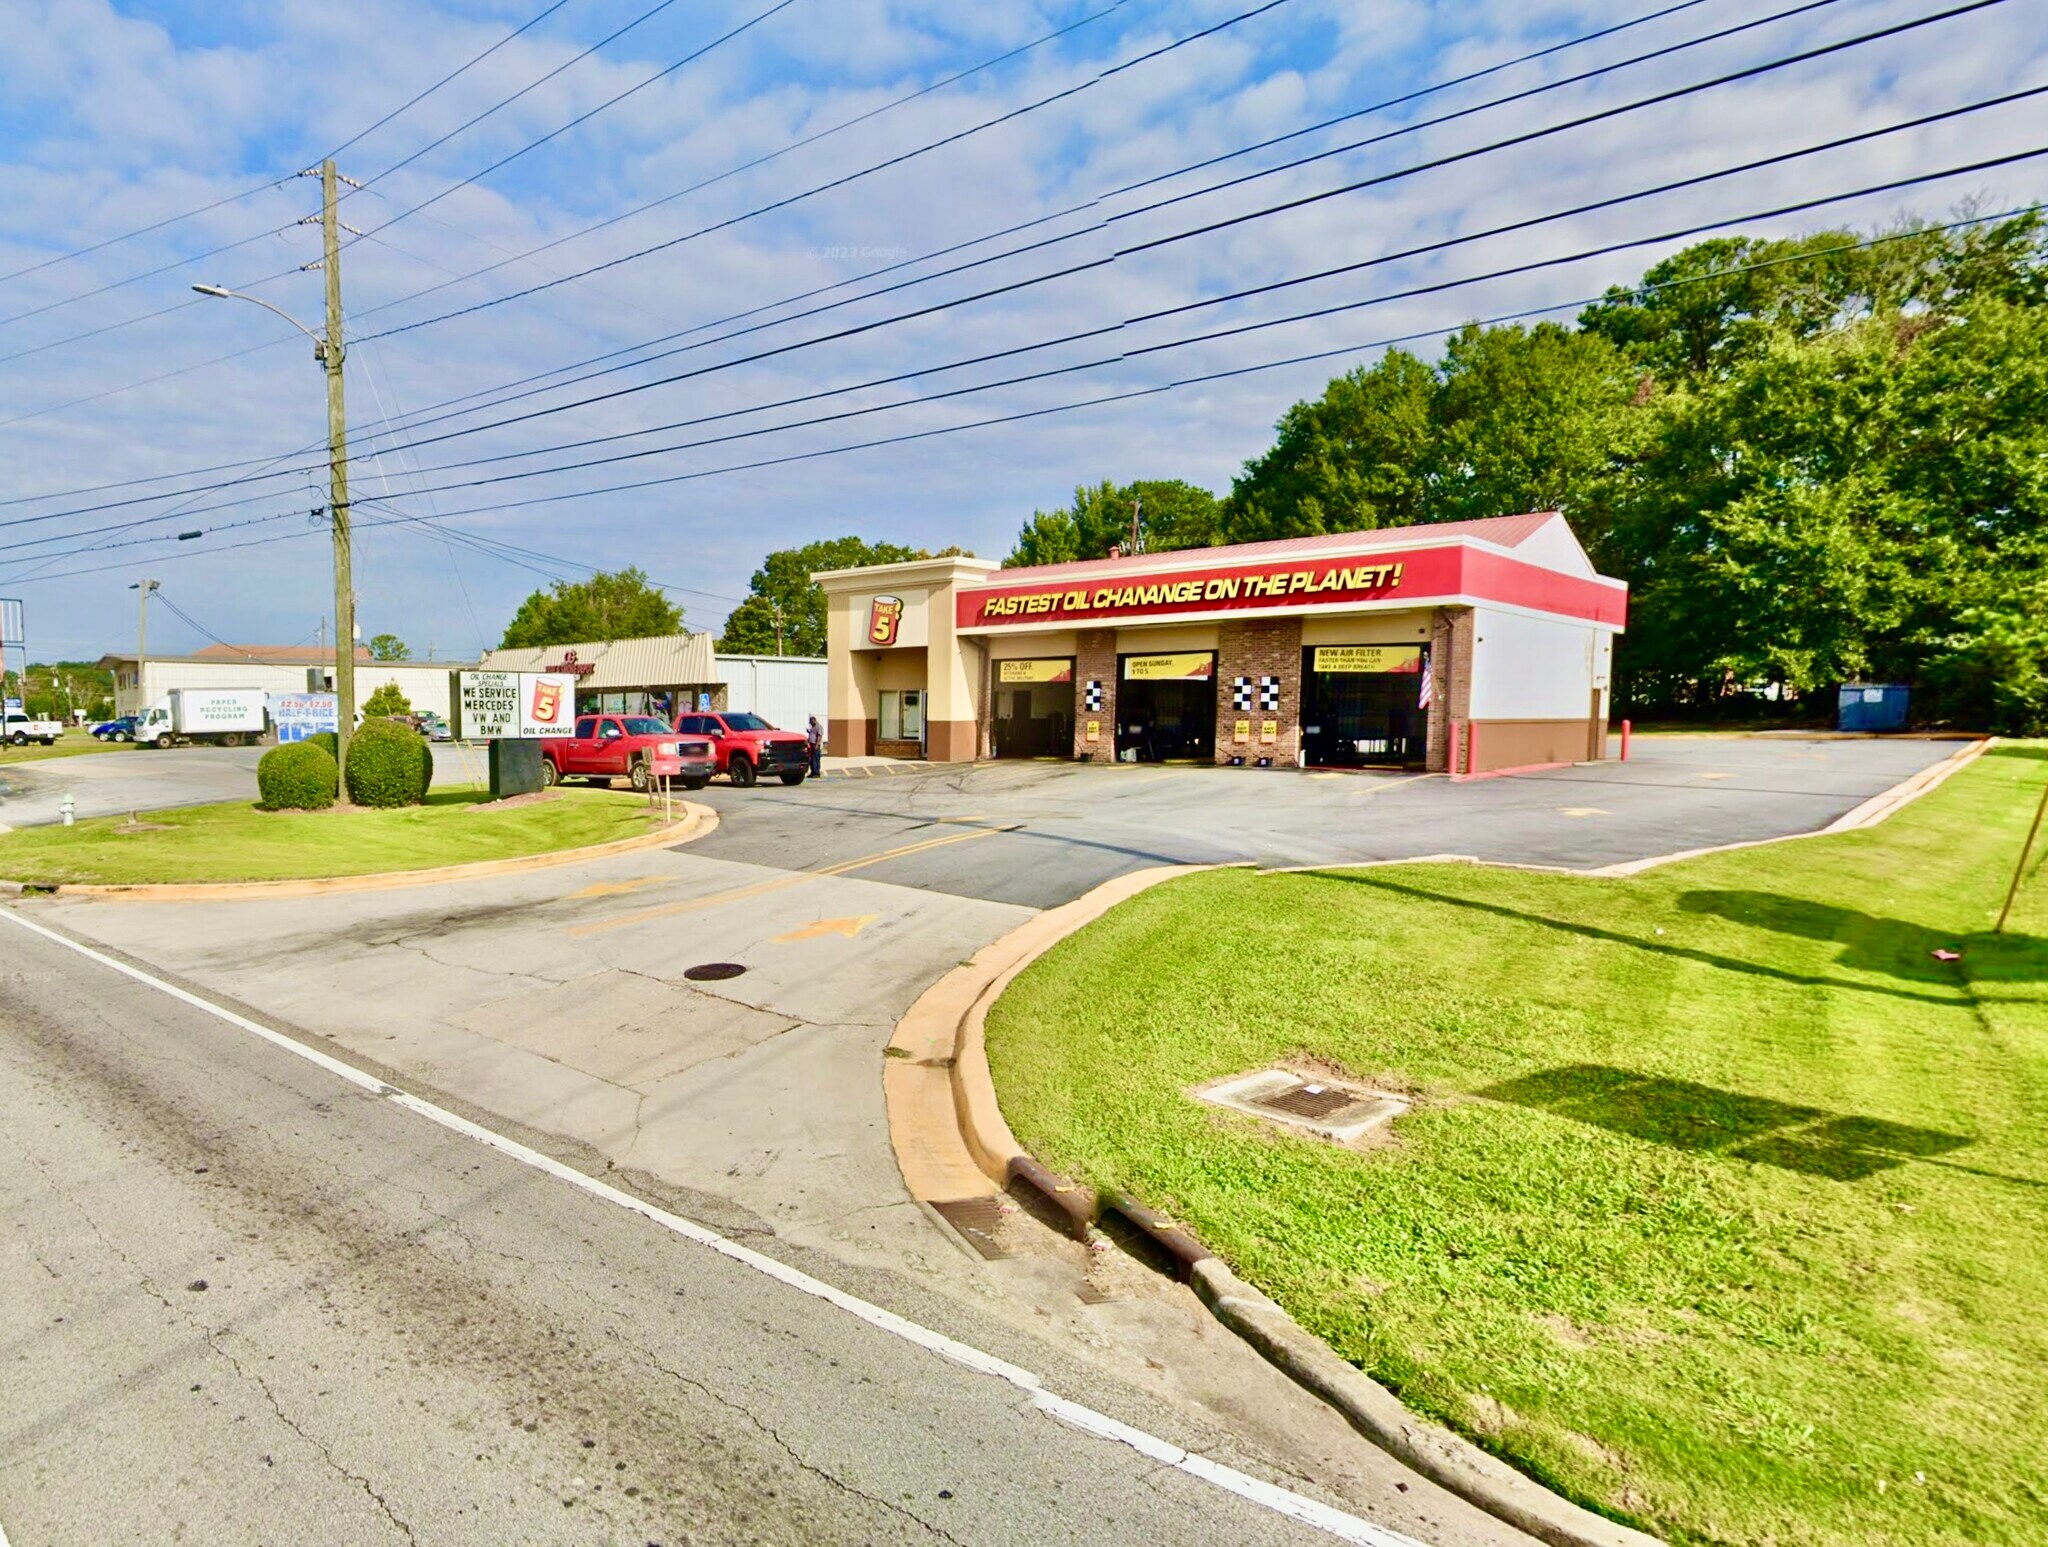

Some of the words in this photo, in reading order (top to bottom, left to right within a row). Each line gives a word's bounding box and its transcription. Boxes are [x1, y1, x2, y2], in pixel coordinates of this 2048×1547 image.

[984, 593, 1063, 616] FASTEST
[1063, 590, 1090, 611] OIL
[1093, 581, 1205, 608] CHANANGE
[1204, 577, 1241, 602] ON
[1244, 574, 1289, 597] THE
[1289, 563, 1404, 594] PLANET!
[874, 602, 896, 615] TAKE
[872, 616, 891, 641] 5
[1319, 648, 1339, 656] NEW
[1340, 648, 1354, 656] AIR
[1003, 662, 1018, 671] 25%
[1132, 660, 1148, 668] OPEN
[470, 673, 480, 681] OIL
[482, 673, 508, 681] CHANGE
[463, 687, 476, 698] WE
[479, 687, 517, 699] SERVICE
[537, 684, 558, 696] TAKE
[464, 700, 514, 711] MERCEDES
[535, 696, 555, 721] 5
[278, 708, 334, 717] HALF-PRICE
[472, 713, 487, 723] VW
[493, 713, 511, 723] AND
[480, 725, 502, 736] BMW
[523, 727, 536, 735] OIL
[539, 727, 573, 735] CHANGE
